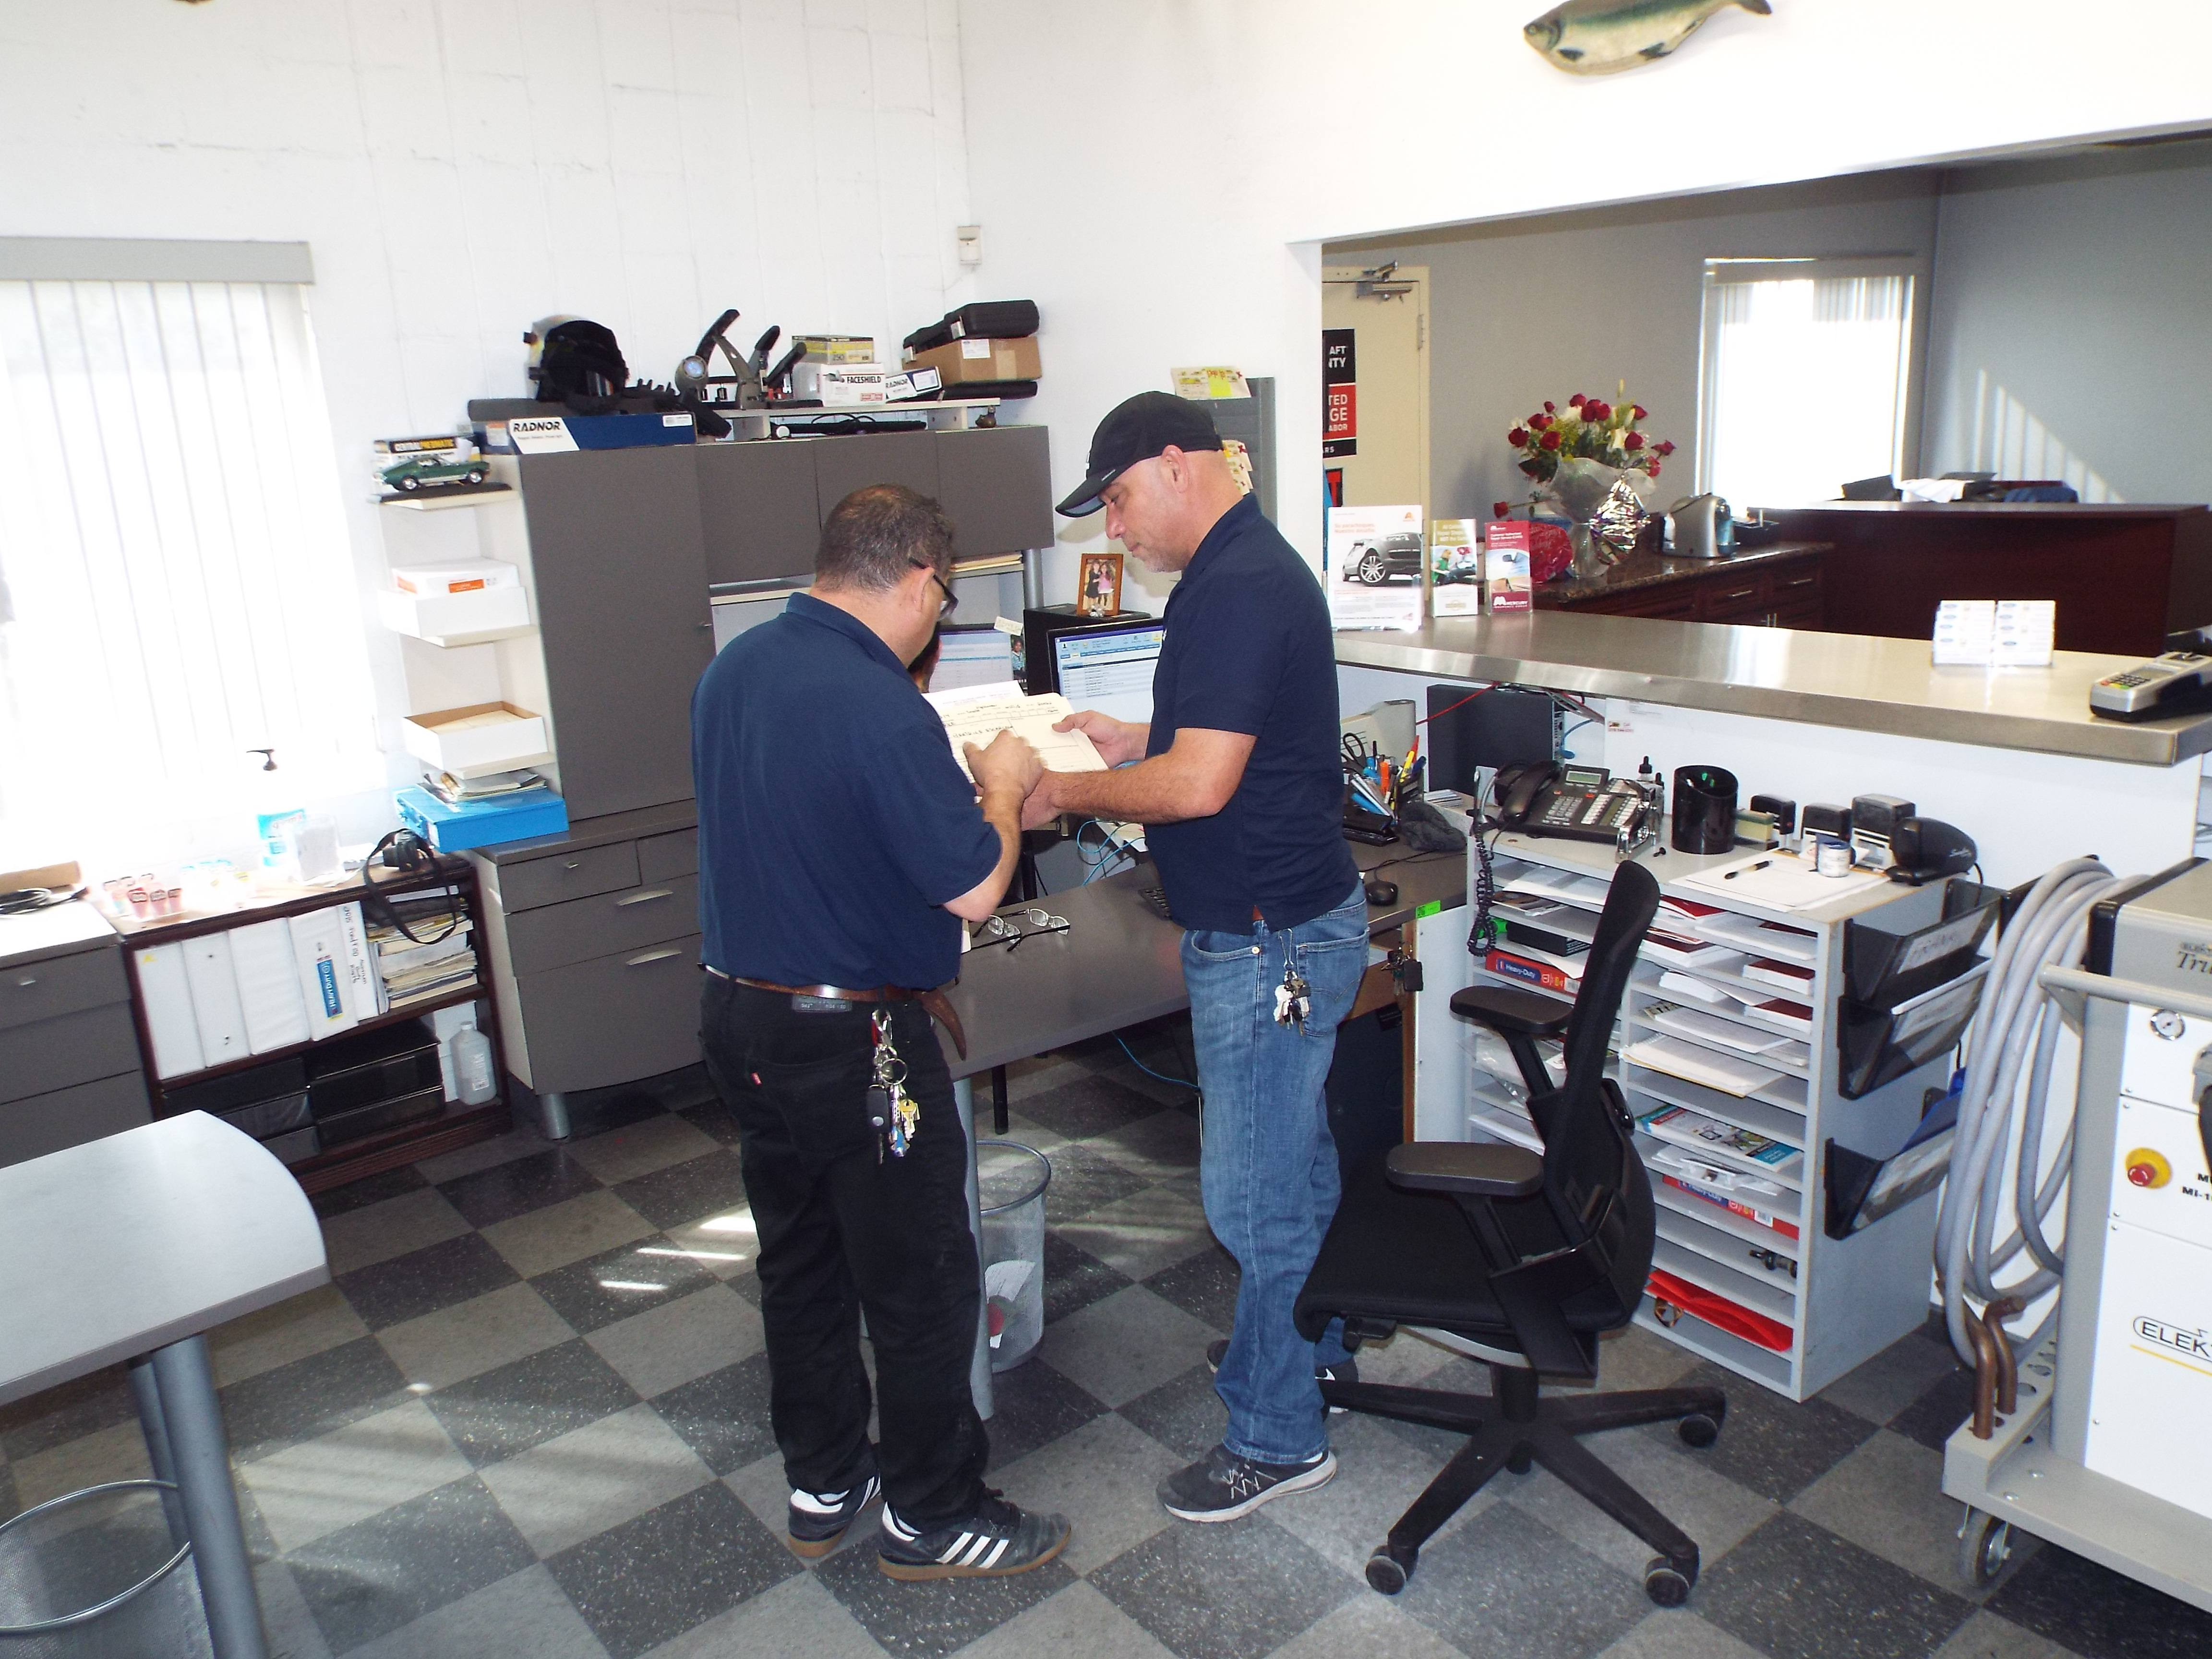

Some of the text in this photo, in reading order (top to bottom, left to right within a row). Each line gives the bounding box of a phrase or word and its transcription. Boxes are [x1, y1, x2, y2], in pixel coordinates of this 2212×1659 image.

[885, 378, 909, 388] RADNOR
[514, 421, 561, 432] RADNOR
[1505, 964, 1536, 979] Heavy-Duty
